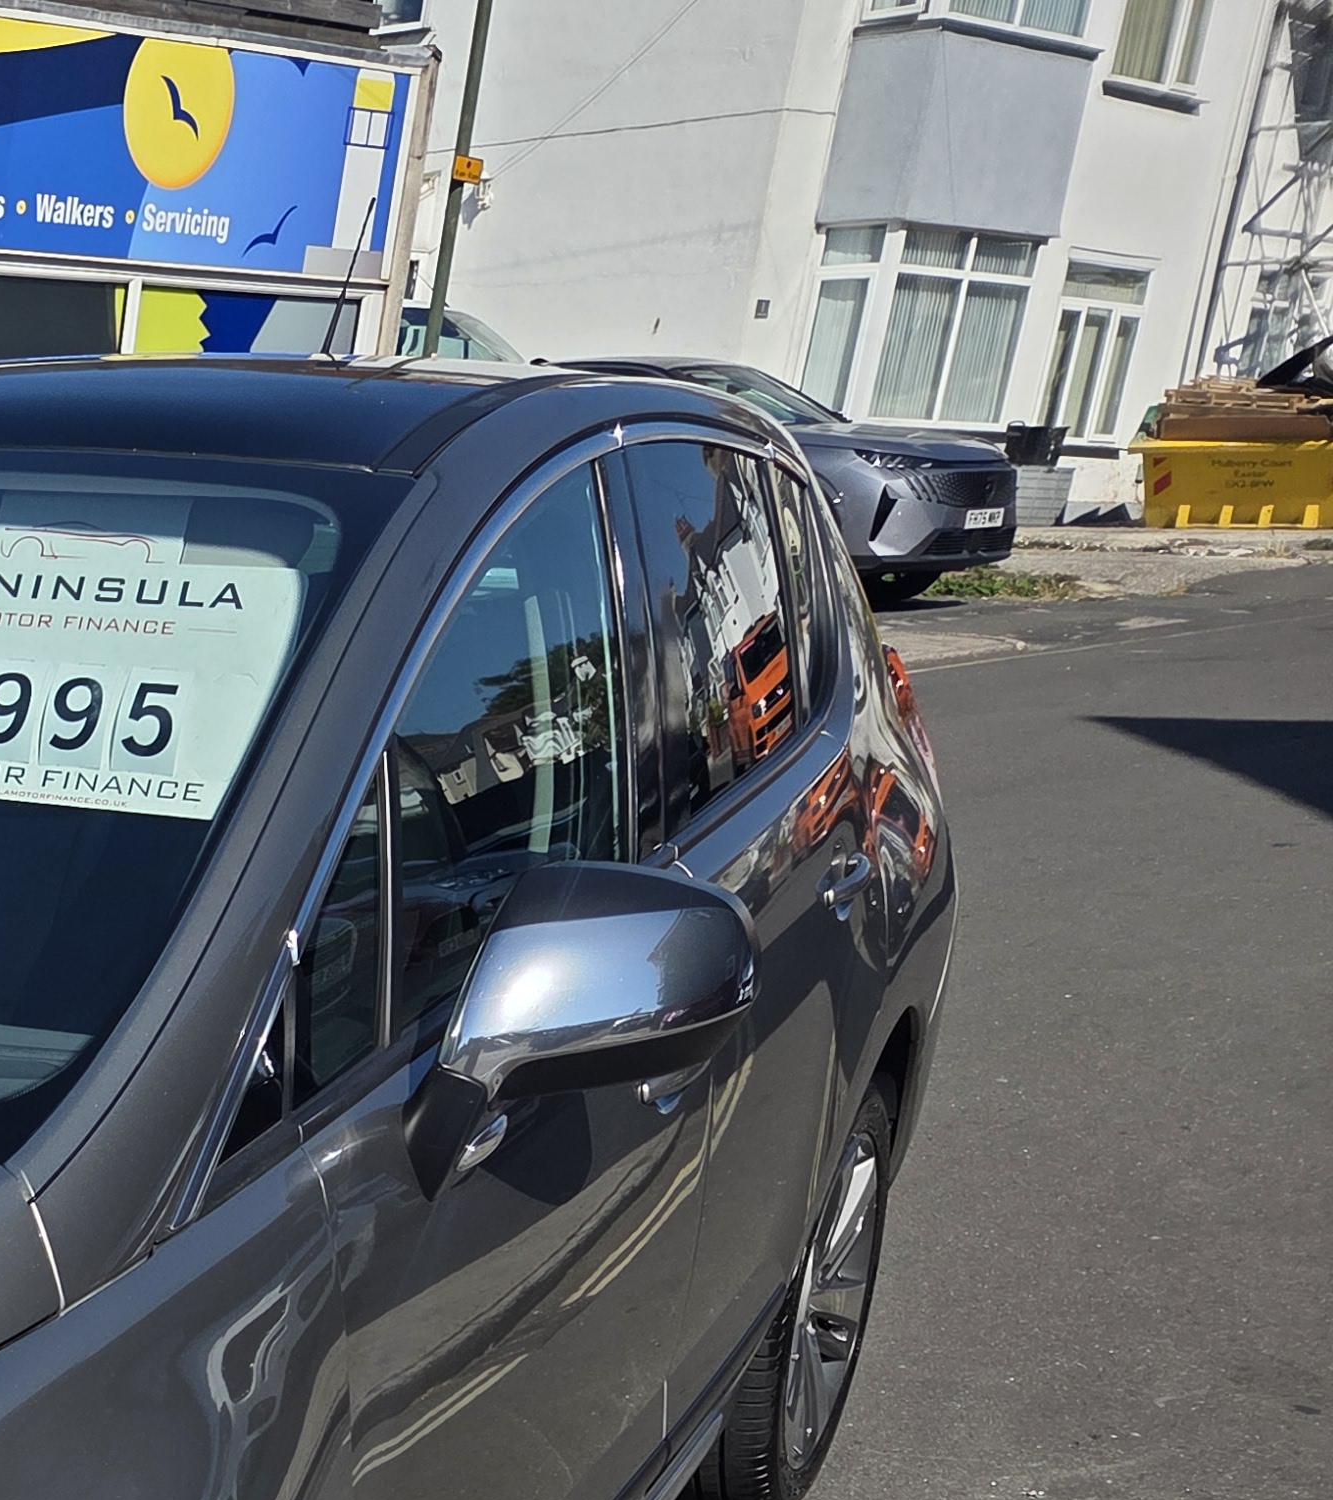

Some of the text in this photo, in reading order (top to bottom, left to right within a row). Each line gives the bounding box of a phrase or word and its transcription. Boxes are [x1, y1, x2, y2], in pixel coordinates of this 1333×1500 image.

[36, 193, 115, 229] Walkers
[142, 203, 230, 244] Servicing
[63, 615, 176, 635] FINANCE
[41, 769, 204, 803] FINANCE
